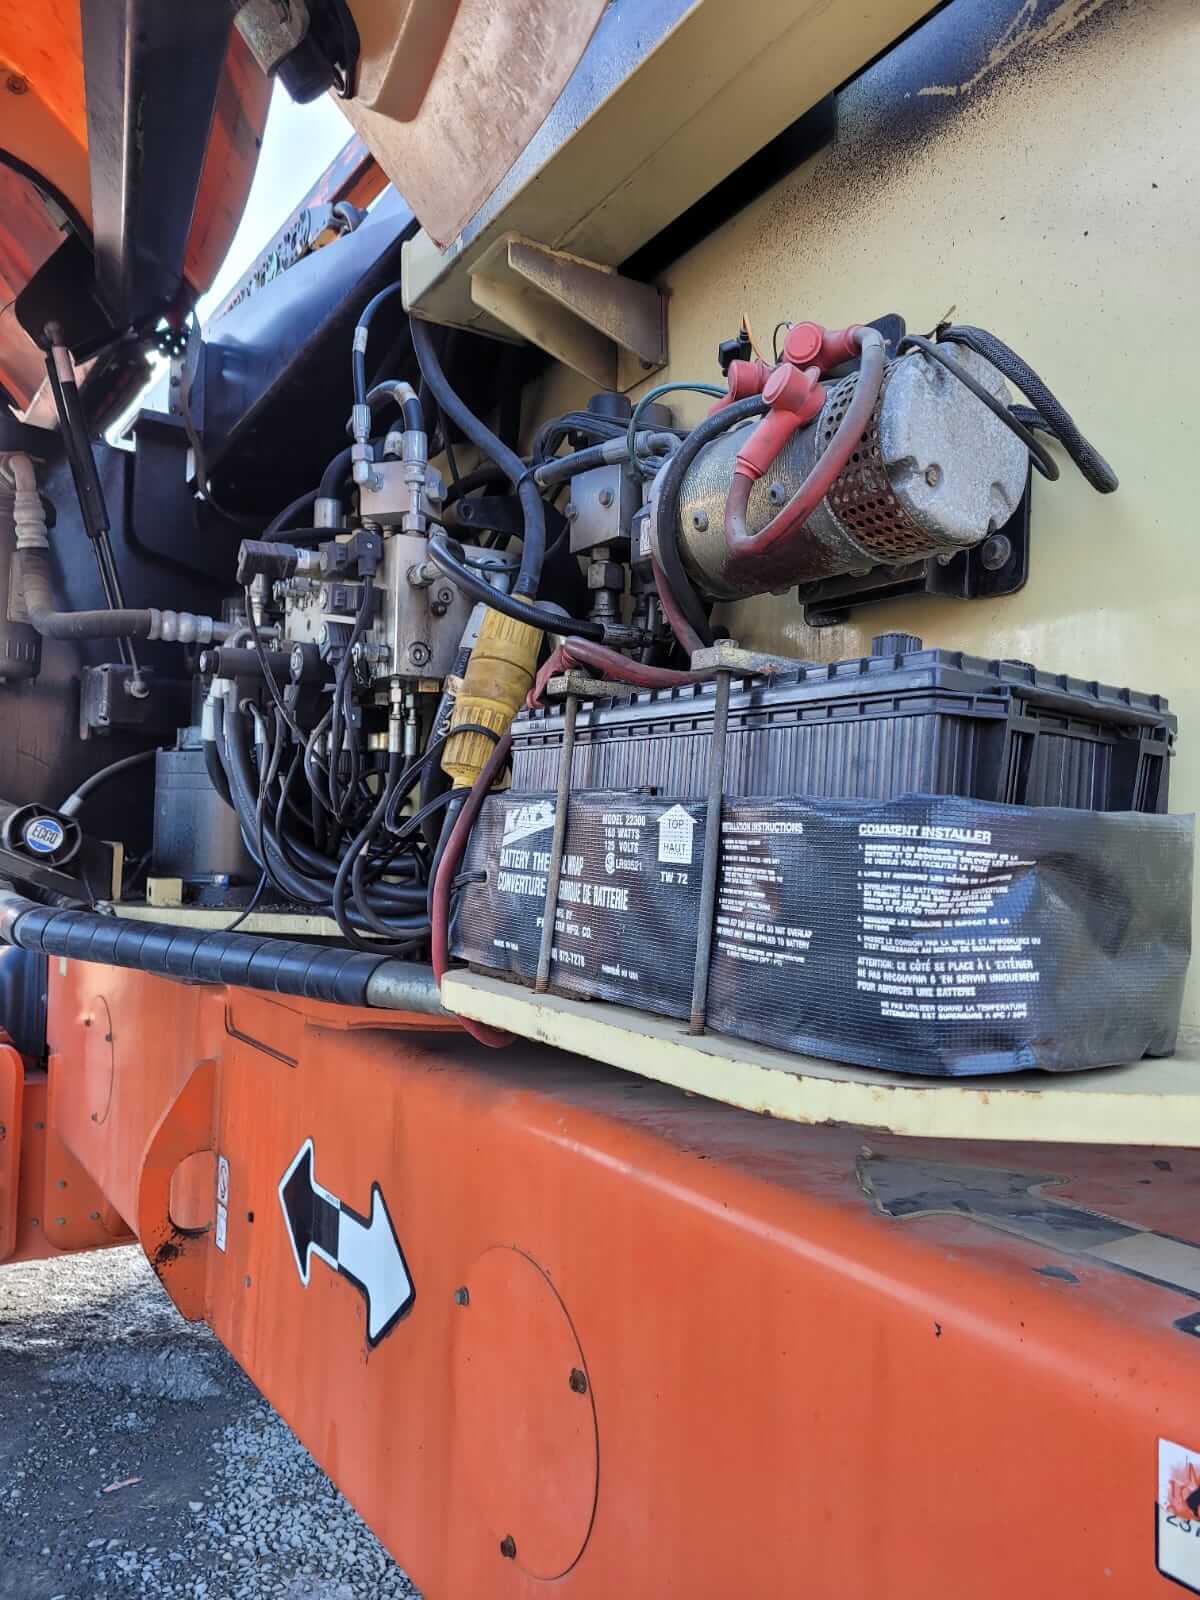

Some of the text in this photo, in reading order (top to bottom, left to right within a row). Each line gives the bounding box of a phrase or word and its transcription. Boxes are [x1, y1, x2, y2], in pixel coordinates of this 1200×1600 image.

[602, 814, 624, 826] MODEL
[668, 818, 684, 830] TOP
[618, 828, 641, 840] WATTS
[751, 822, 804, 834] INSTRUCTIONS
[858, 823, 992, 844] COMMENT INSTALLER
[619, 840, 640, 853] VOLTS
[663, 842, 687, 856] HAUT
[500, 848, 530, 869] BATTERY
[660, 872, 688, 885] TW 72
[583, 884, 592, 905] DE
[594, 886, 629, 910] BATTERIE
[909, 958, 931, 972] CÔTÉ
[948, 960, 975, 972] PLACE
[988, 971, 1040, 984] UNIQUEMENT
[857, 980, 876, 992] POUR
